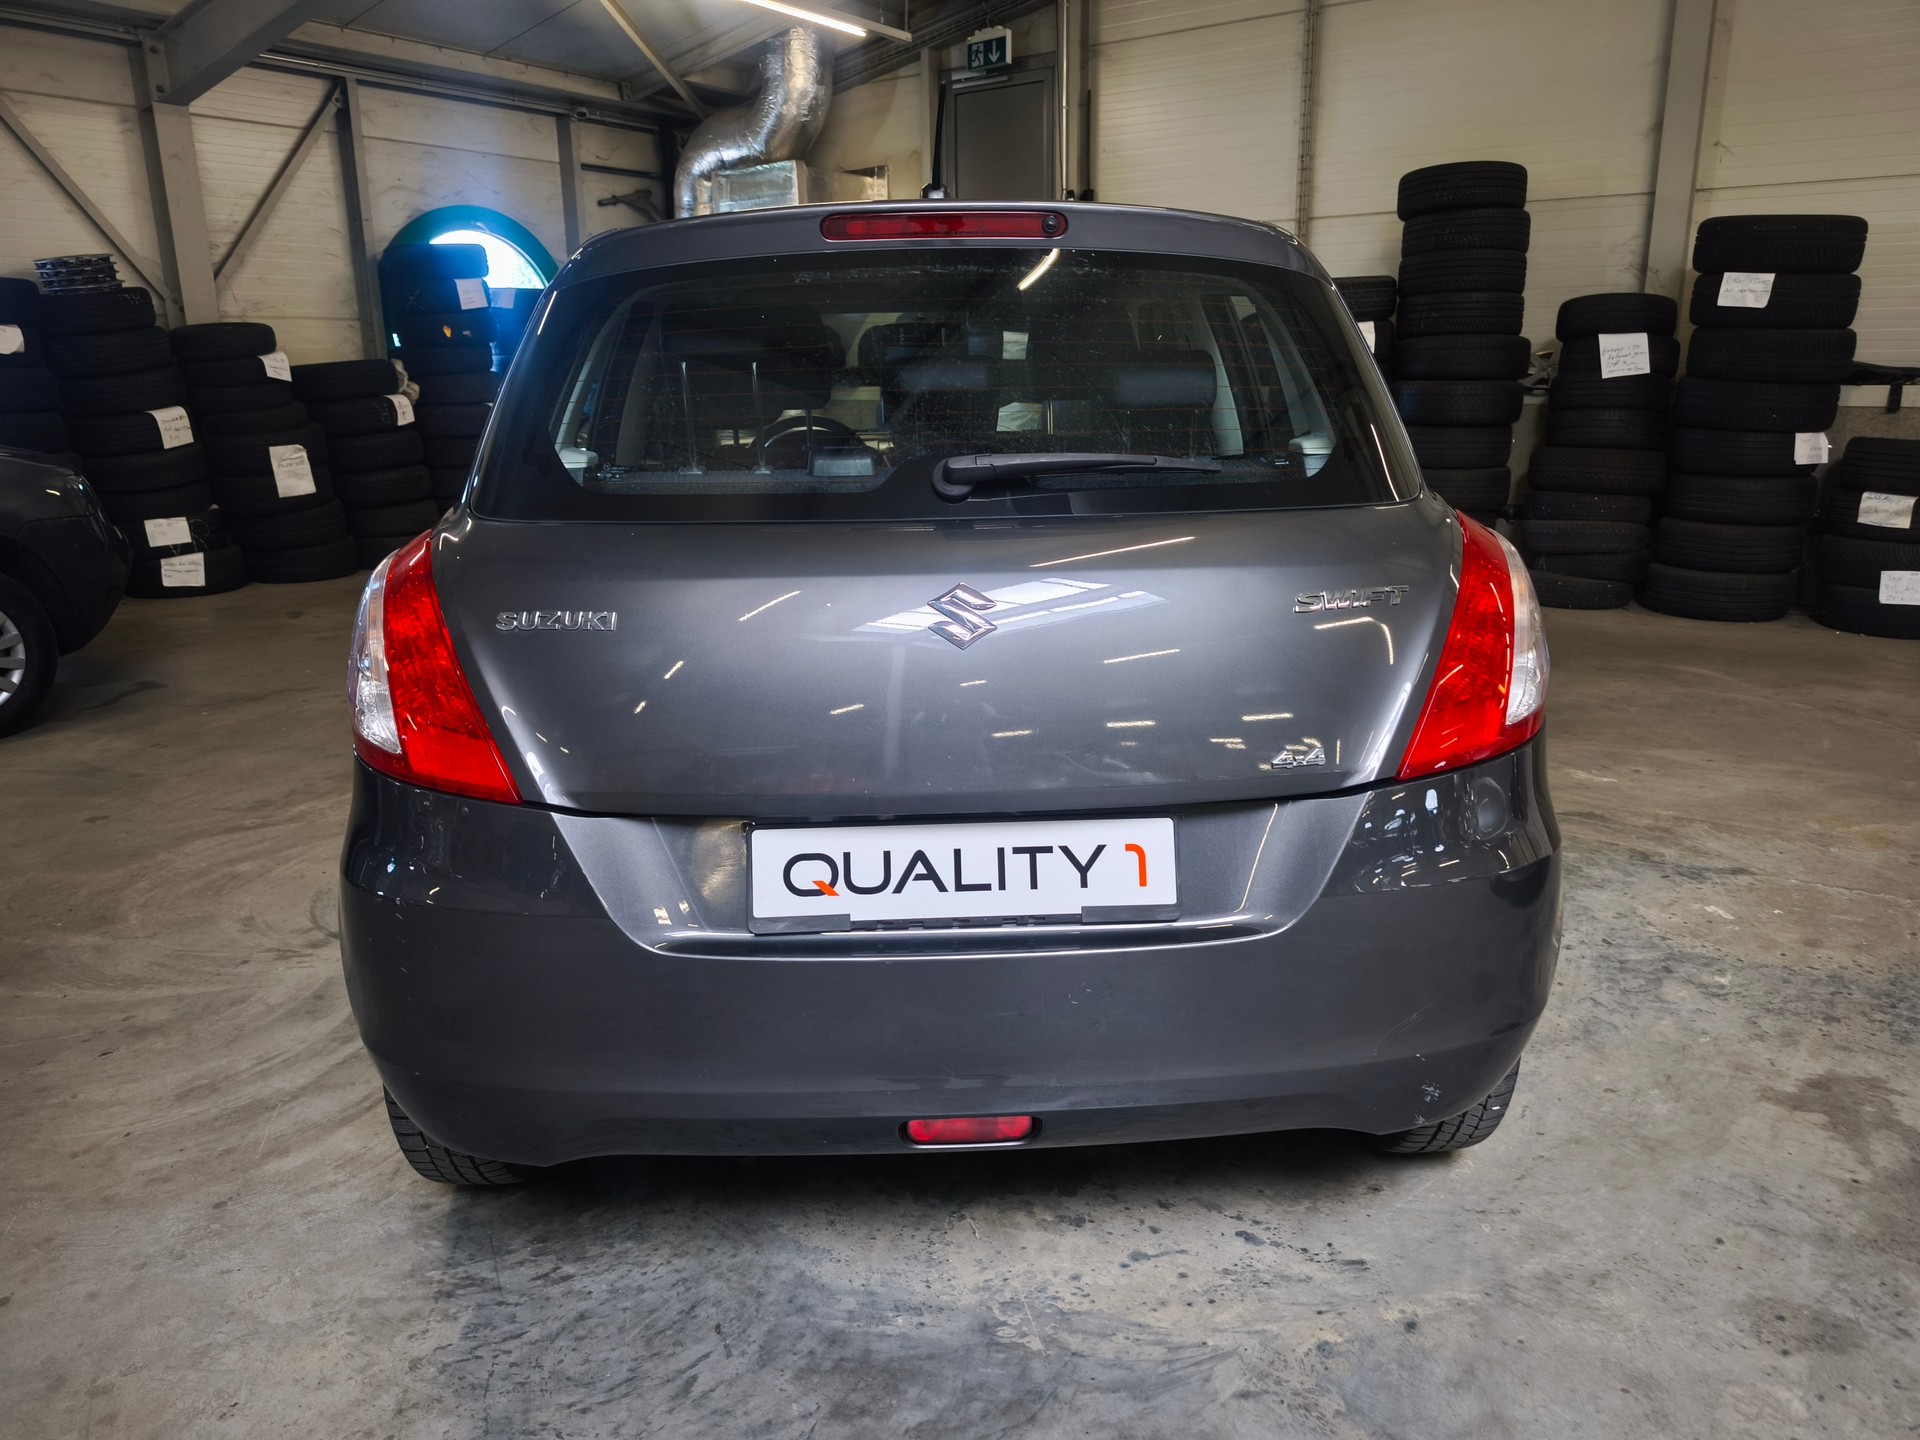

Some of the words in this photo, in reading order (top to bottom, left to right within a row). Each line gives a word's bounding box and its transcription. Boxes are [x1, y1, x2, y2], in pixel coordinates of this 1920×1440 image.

[1293, 585, 1409, 613] SWIFT
[495, 610, 618, 631] SUZUKI
[782, 843, 1107, 897] QUALITY
[1124, 843, 1148, 887] 1
